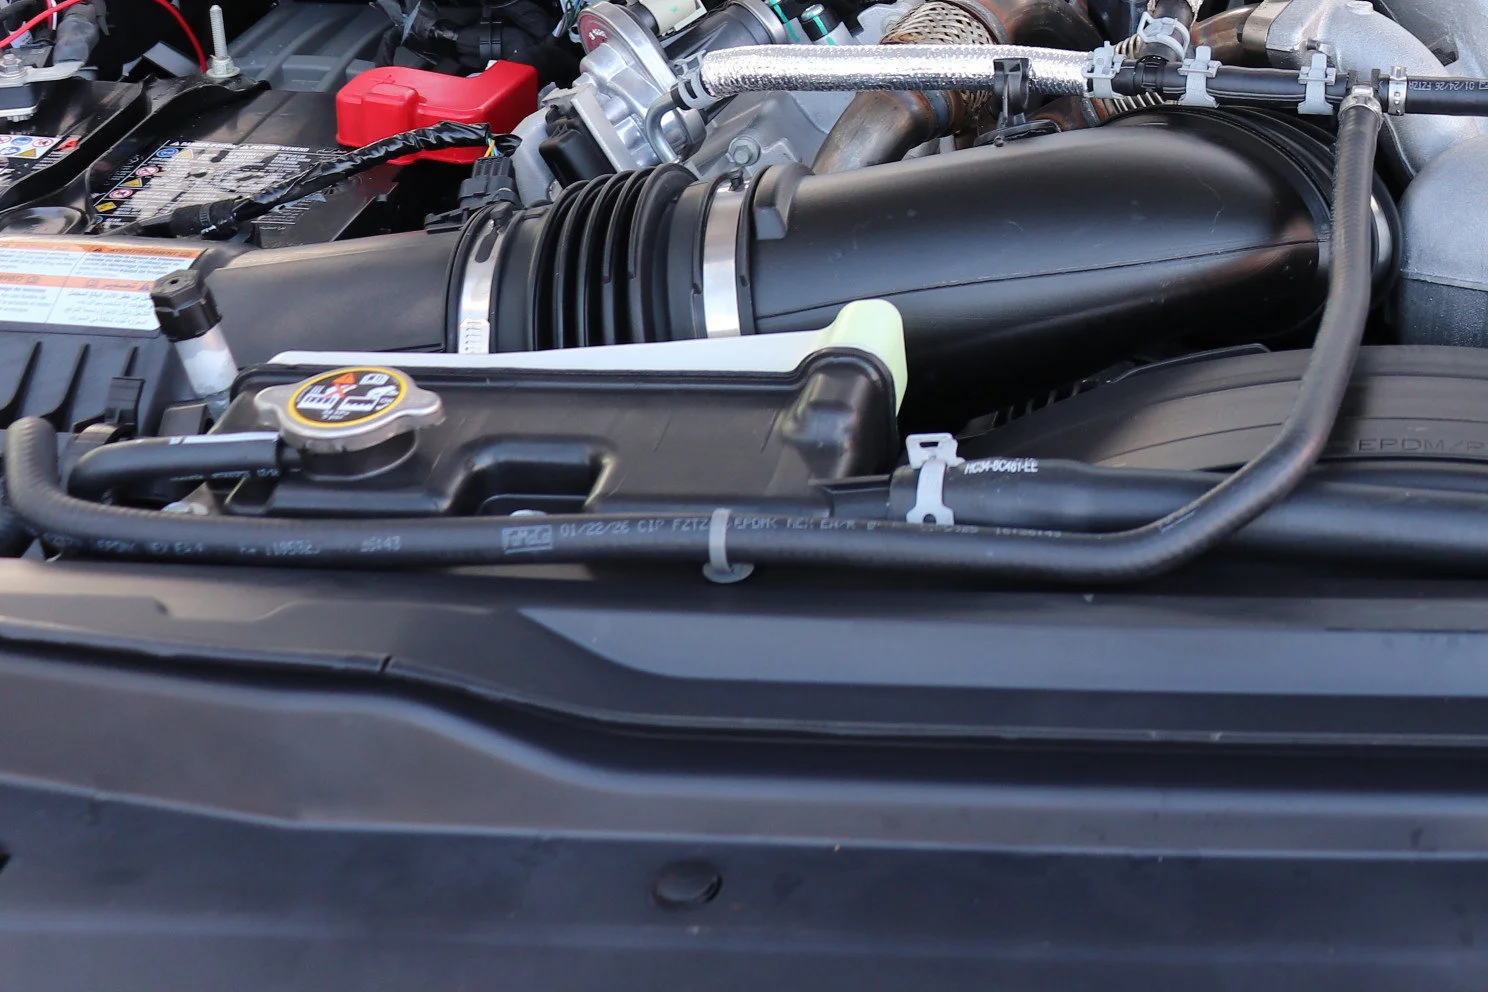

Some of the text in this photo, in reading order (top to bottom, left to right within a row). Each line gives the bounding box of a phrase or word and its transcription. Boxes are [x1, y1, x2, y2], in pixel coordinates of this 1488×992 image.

[1434, 80, 1475, 91] 01/24/26
[560, 522, 630, 538] 01/22/26
[637, 519, 664, 533] CIP
[672, 518, 710, 532] FZTZ
